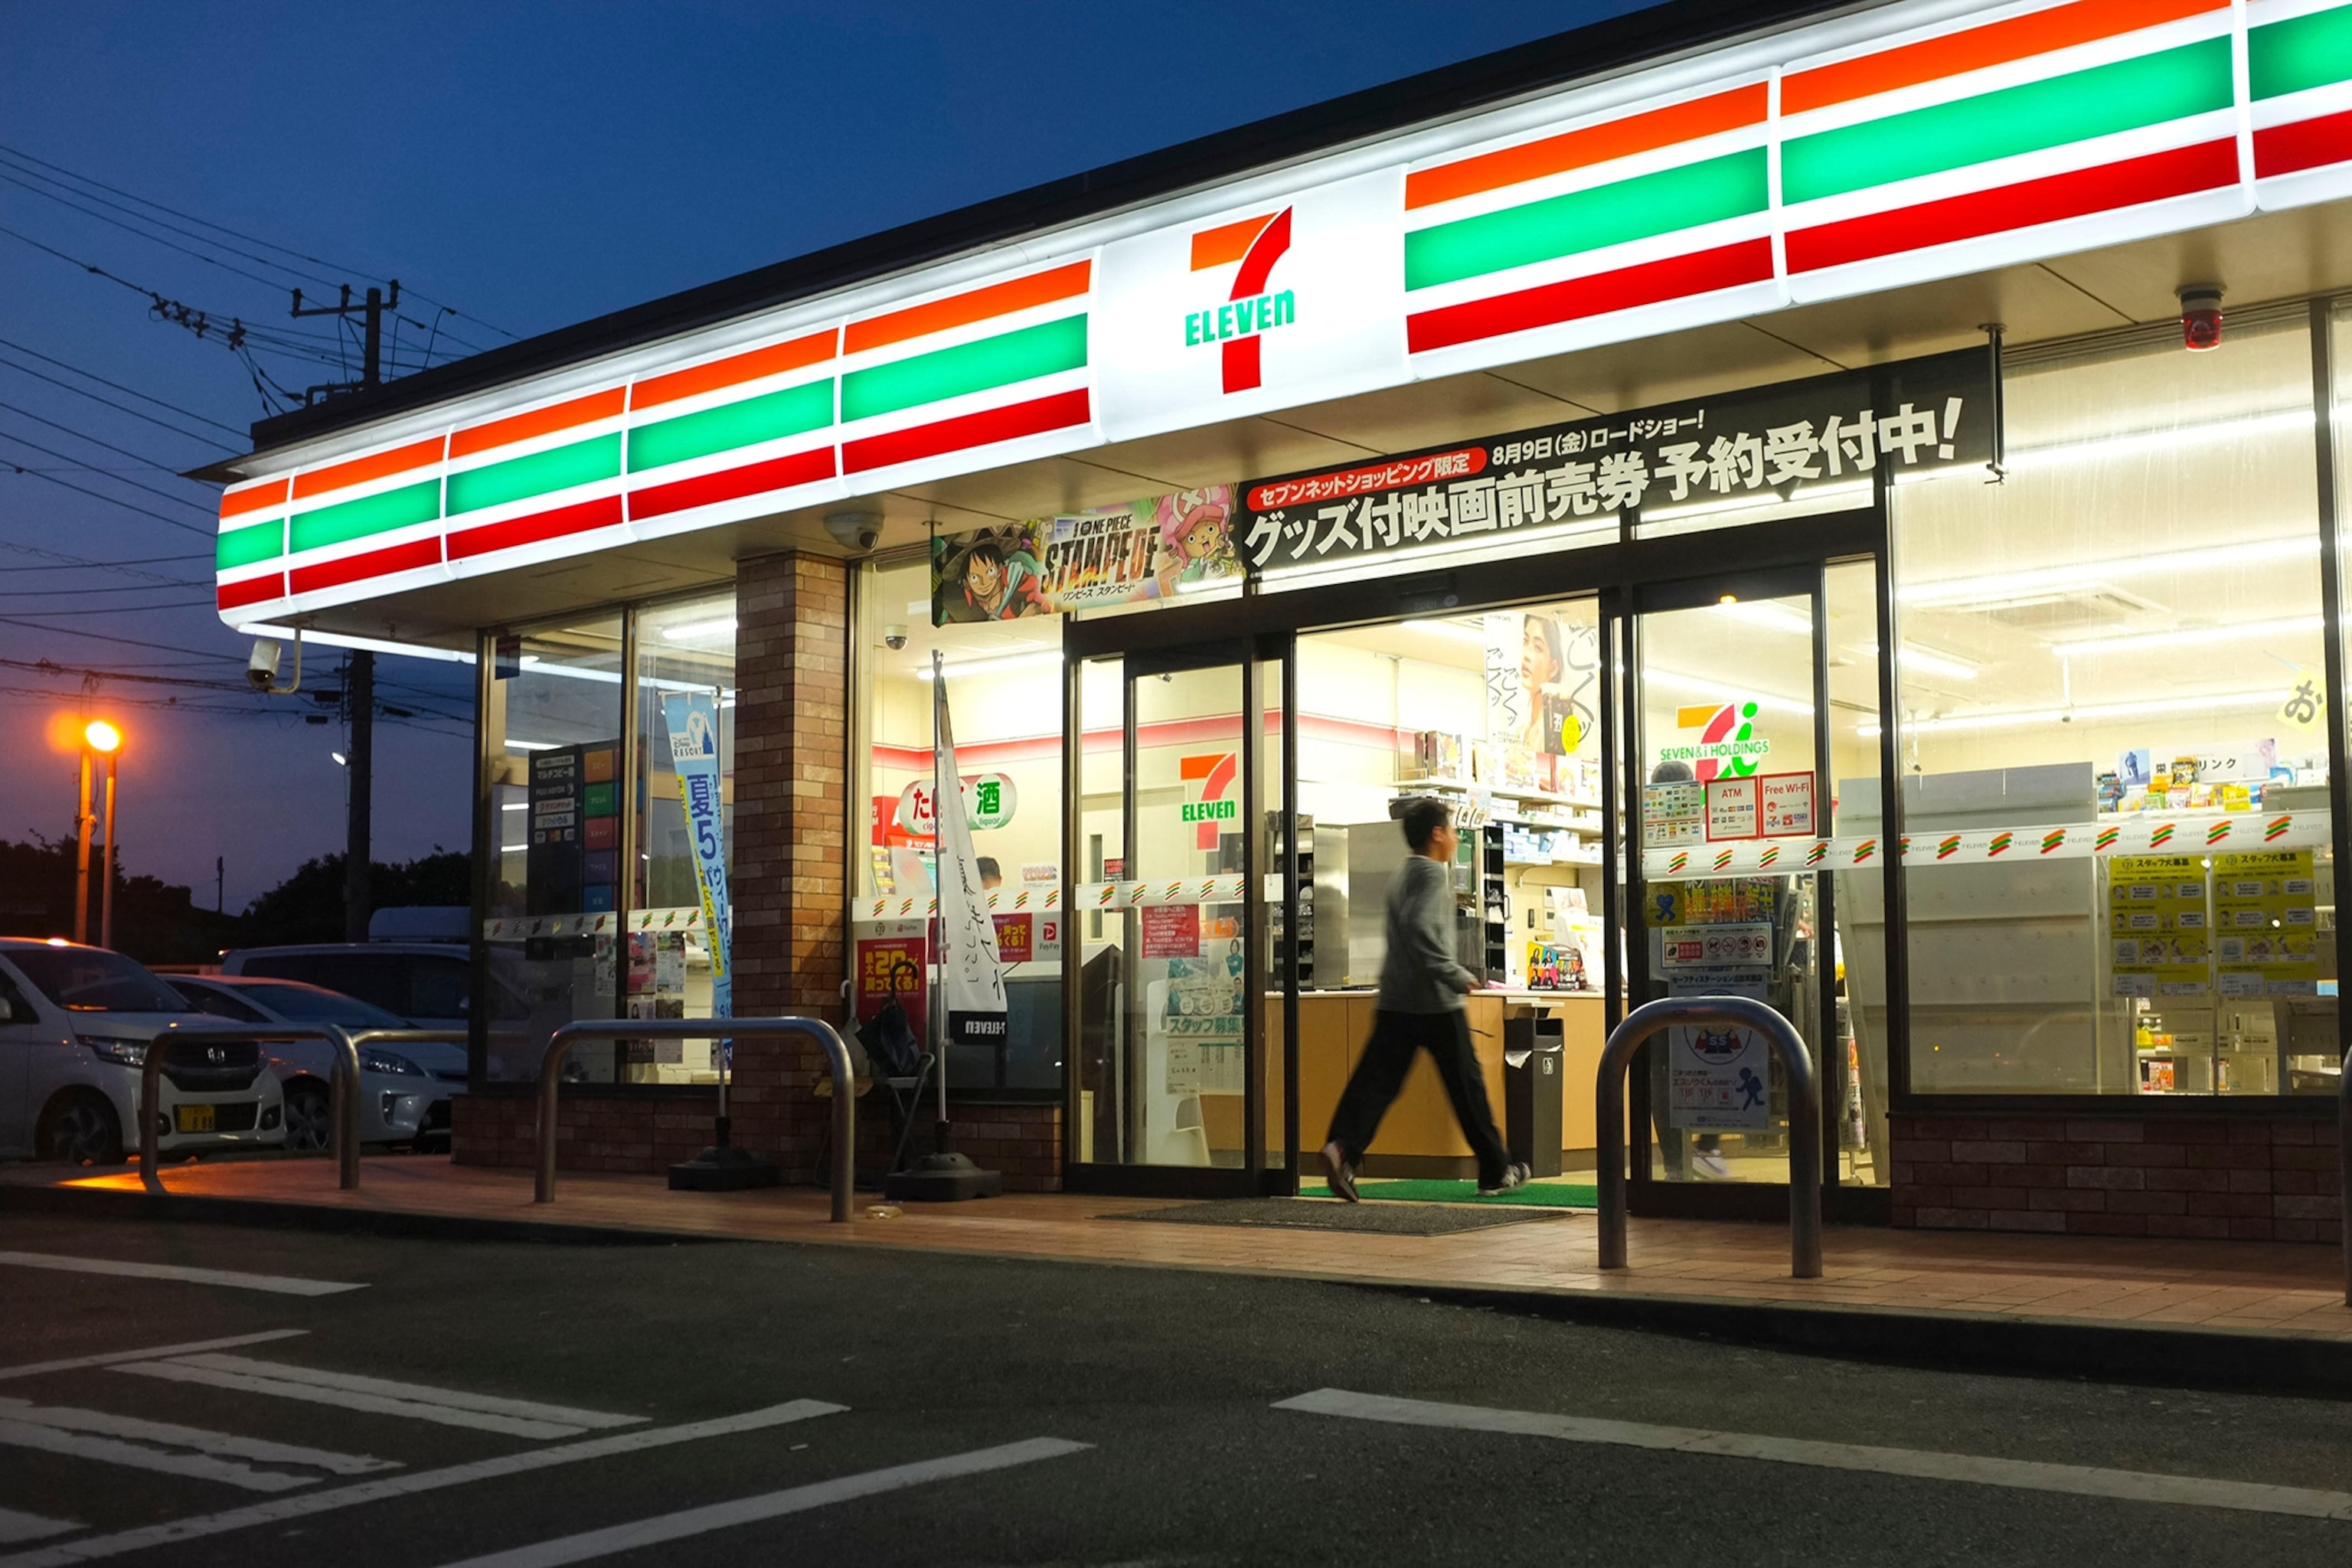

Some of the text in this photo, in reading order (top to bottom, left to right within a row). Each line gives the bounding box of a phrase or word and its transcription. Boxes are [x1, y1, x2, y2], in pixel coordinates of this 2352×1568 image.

[1244, 397, 1963, 568] グッズ付映画前売券予約受付中!
[1259, 452, 1471, 508] セブンネットショッピング限定
[1106, 514, 1133, 533] PIECE
[1040, 526, 1161, 595] STAMPEDE
[2284, 679, 2324, 724] お
[674, 746, 703, 757] RESORT
[1710, 740, 1769, 756] HOLDINGS
[1721, 788, 1743, 799] ATM
[1765, 782, 1810, 795] Free Wi-Fi
[976, 782, 1000, 815] 酒
[978, 817, 1001, 827] liquor
[1039, 942, 1060, 951] PayPay
[1709, 1034, 1728, 1047] SS
